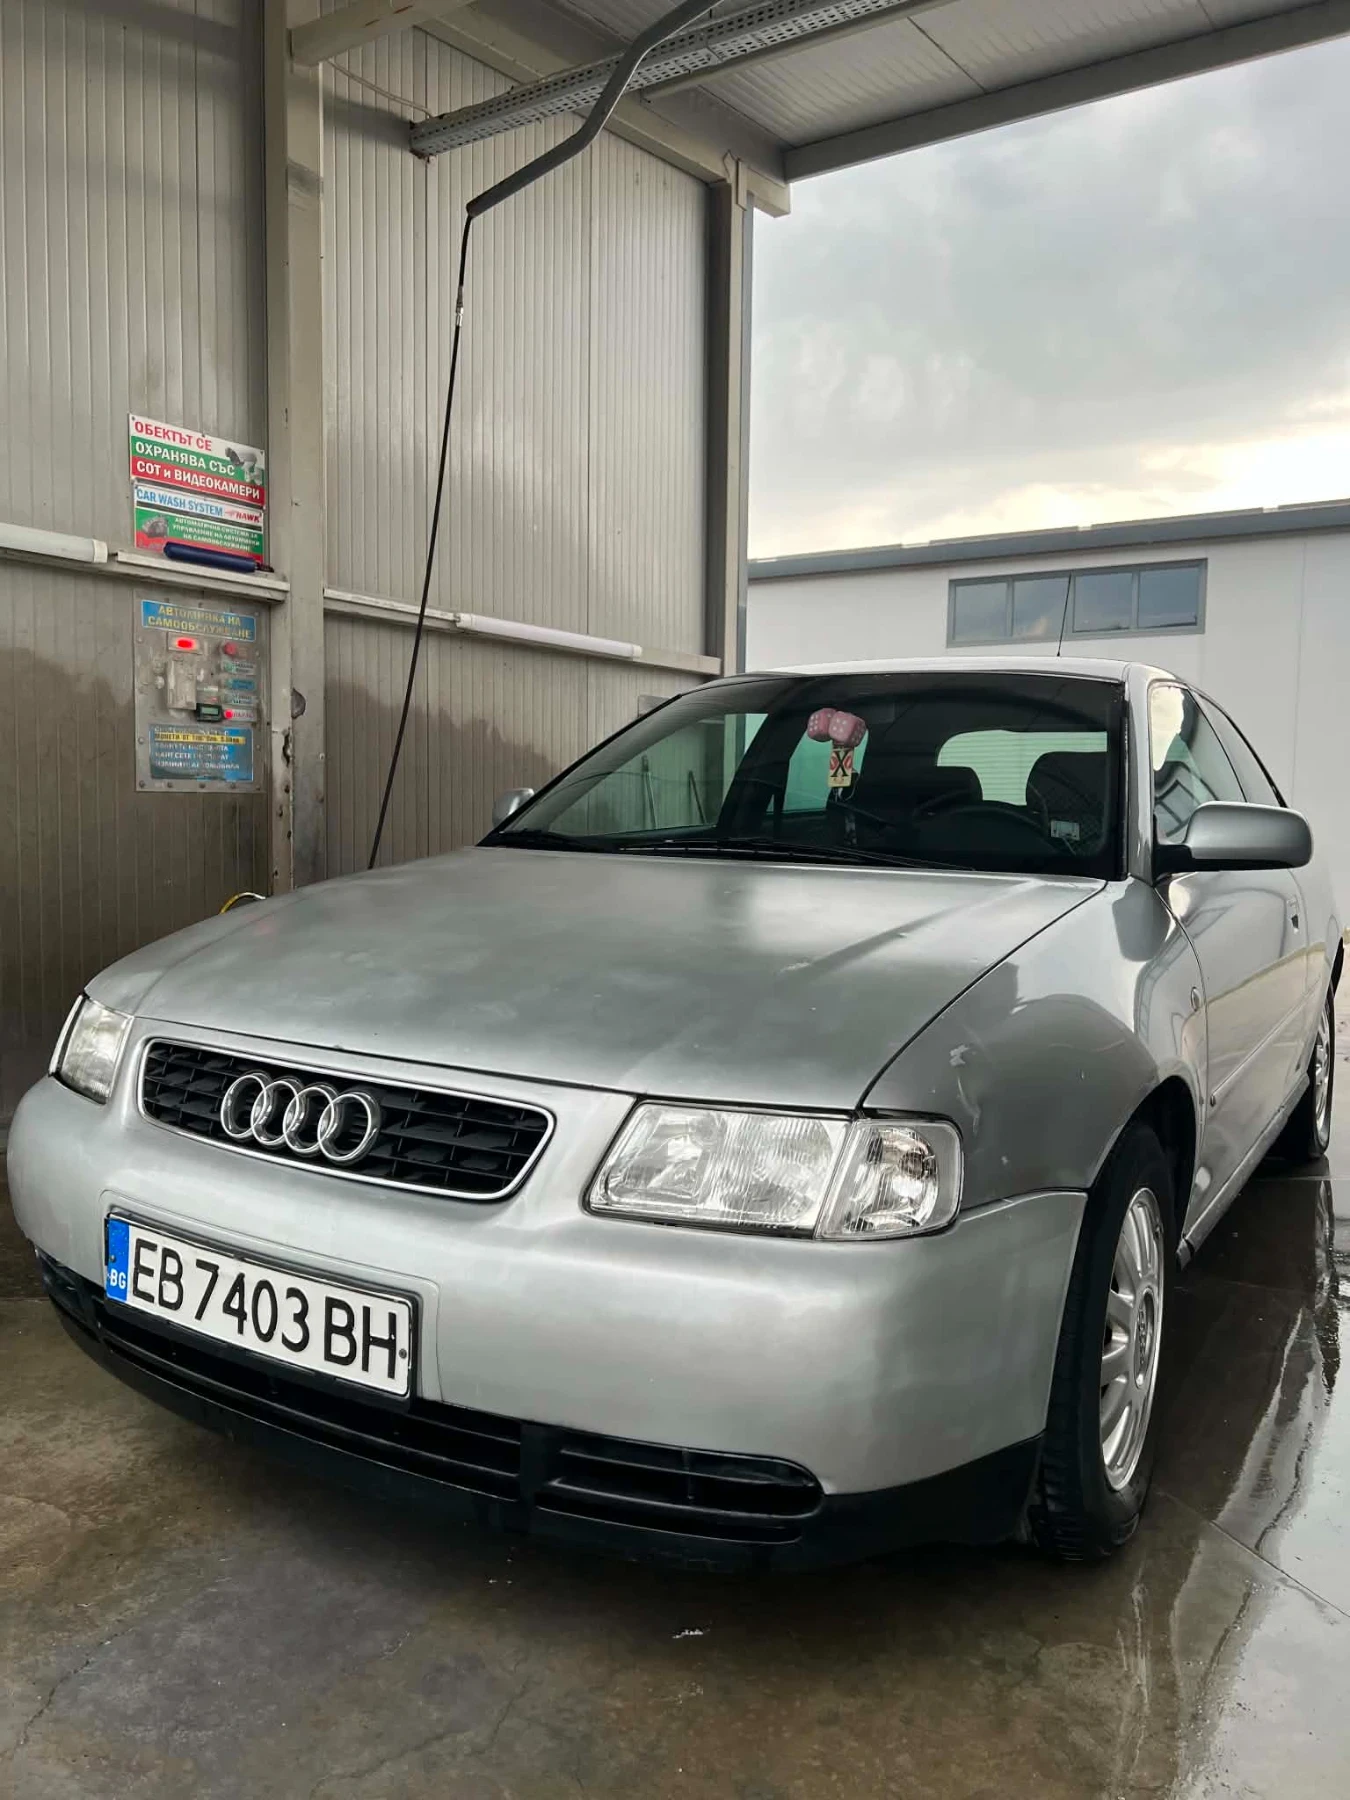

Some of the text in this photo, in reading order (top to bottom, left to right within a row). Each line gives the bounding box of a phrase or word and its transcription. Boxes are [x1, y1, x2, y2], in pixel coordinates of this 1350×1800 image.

[134, 421, 212, 451] ОБЕКТЪТ СЕ
[135, 441, 235, 476] ОХРАНЯВА СЪС
[136, 460, 162, 476] СОТ
[174, 469, 260, 499] ВИДЕОКАМЕРИ
[136, 488, 223, 517] CAR WASH SYSTEM
[235, 512, 260, 524] HAWK
[227, 616, 241, 627] НА
[110, 1268, 127, 1290] BG
